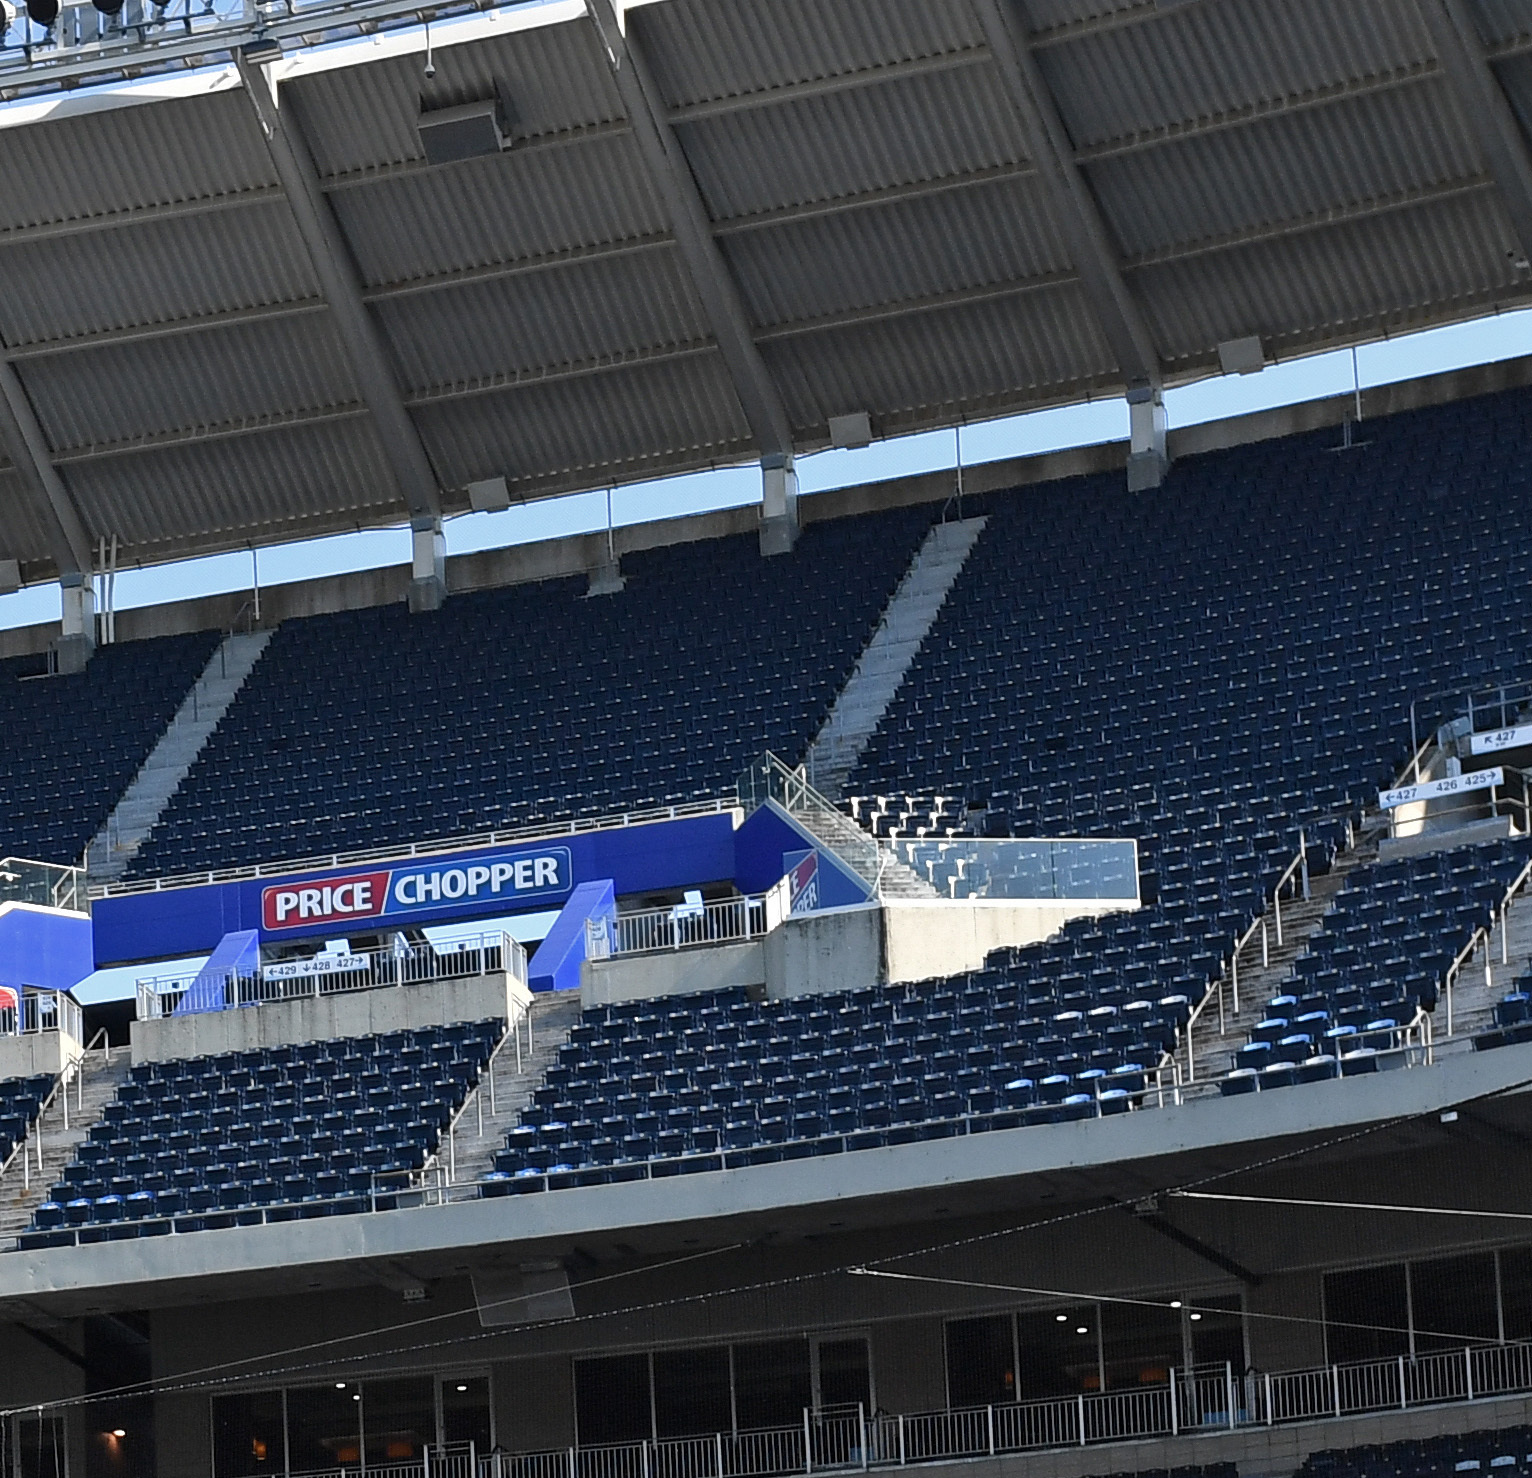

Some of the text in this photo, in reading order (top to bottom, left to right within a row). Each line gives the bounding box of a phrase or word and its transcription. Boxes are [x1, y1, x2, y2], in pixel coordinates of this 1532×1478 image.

[1495, 730, 1515, 742] 427
[1396, 773, 1487, 800] 427 426 425
[275, 857, 559, 921] PRICE CHOPPER
[278, 957, 355, 975] 429 428 427
